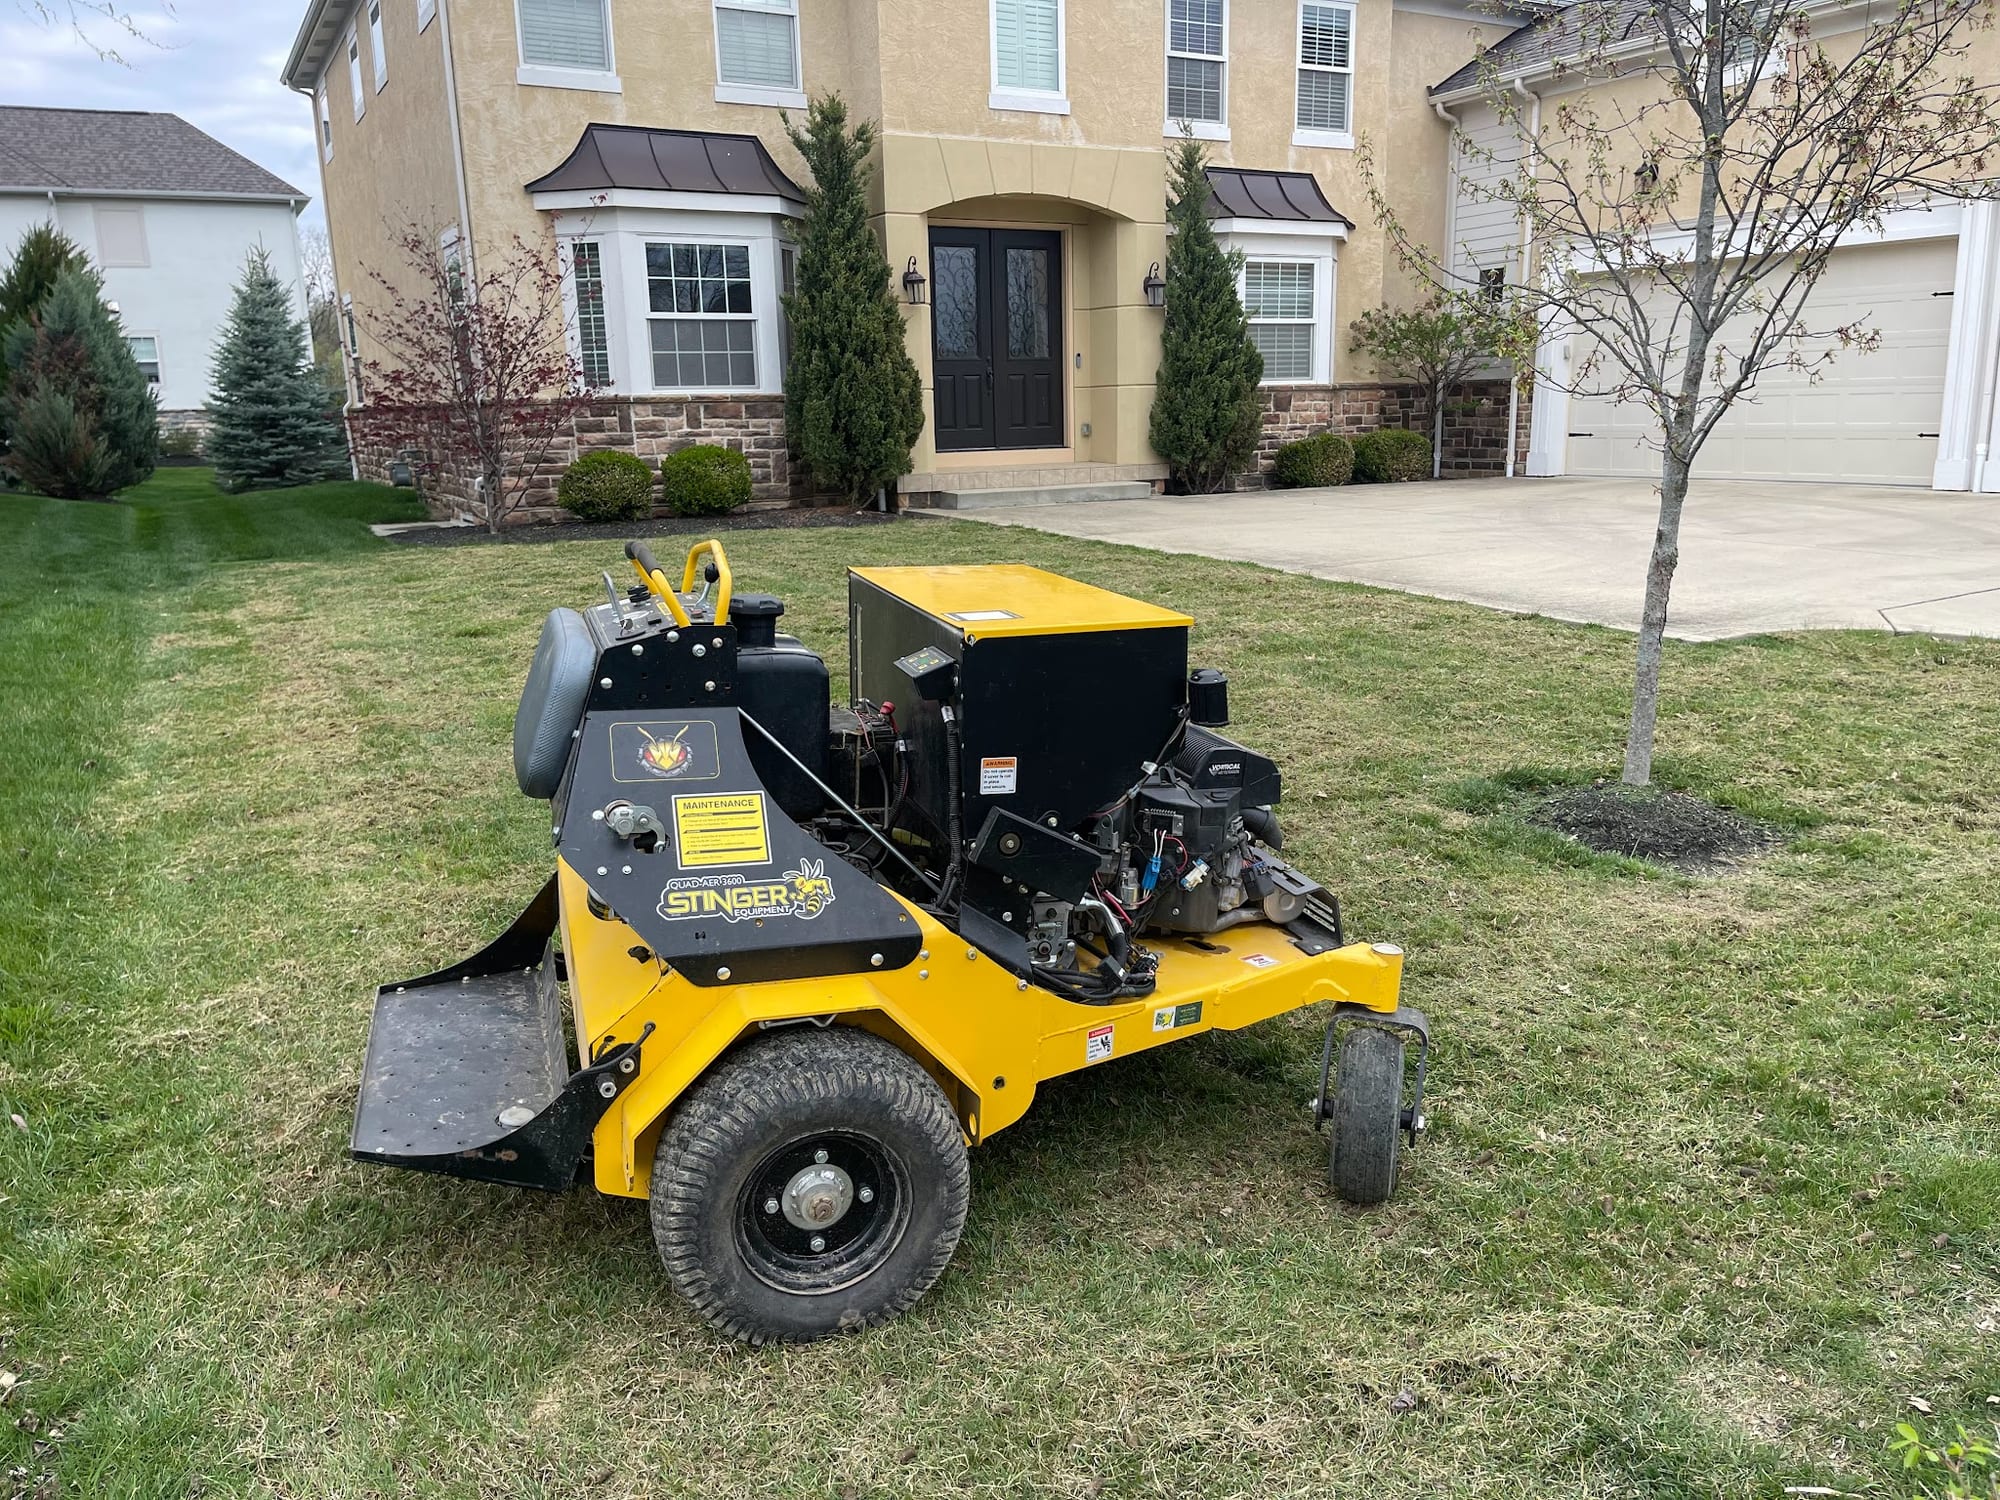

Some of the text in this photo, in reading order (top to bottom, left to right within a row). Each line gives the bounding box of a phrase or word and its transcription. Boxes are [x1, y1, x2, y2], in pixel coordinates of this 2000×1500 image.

[683, 799, 755, 810] MAINTENANCE
[670, 877, 742, 890] QUAD-AER 3600
[664, 884, 791, 917] STINGER
[734, 905, 791, 918] EQUIPMENT
